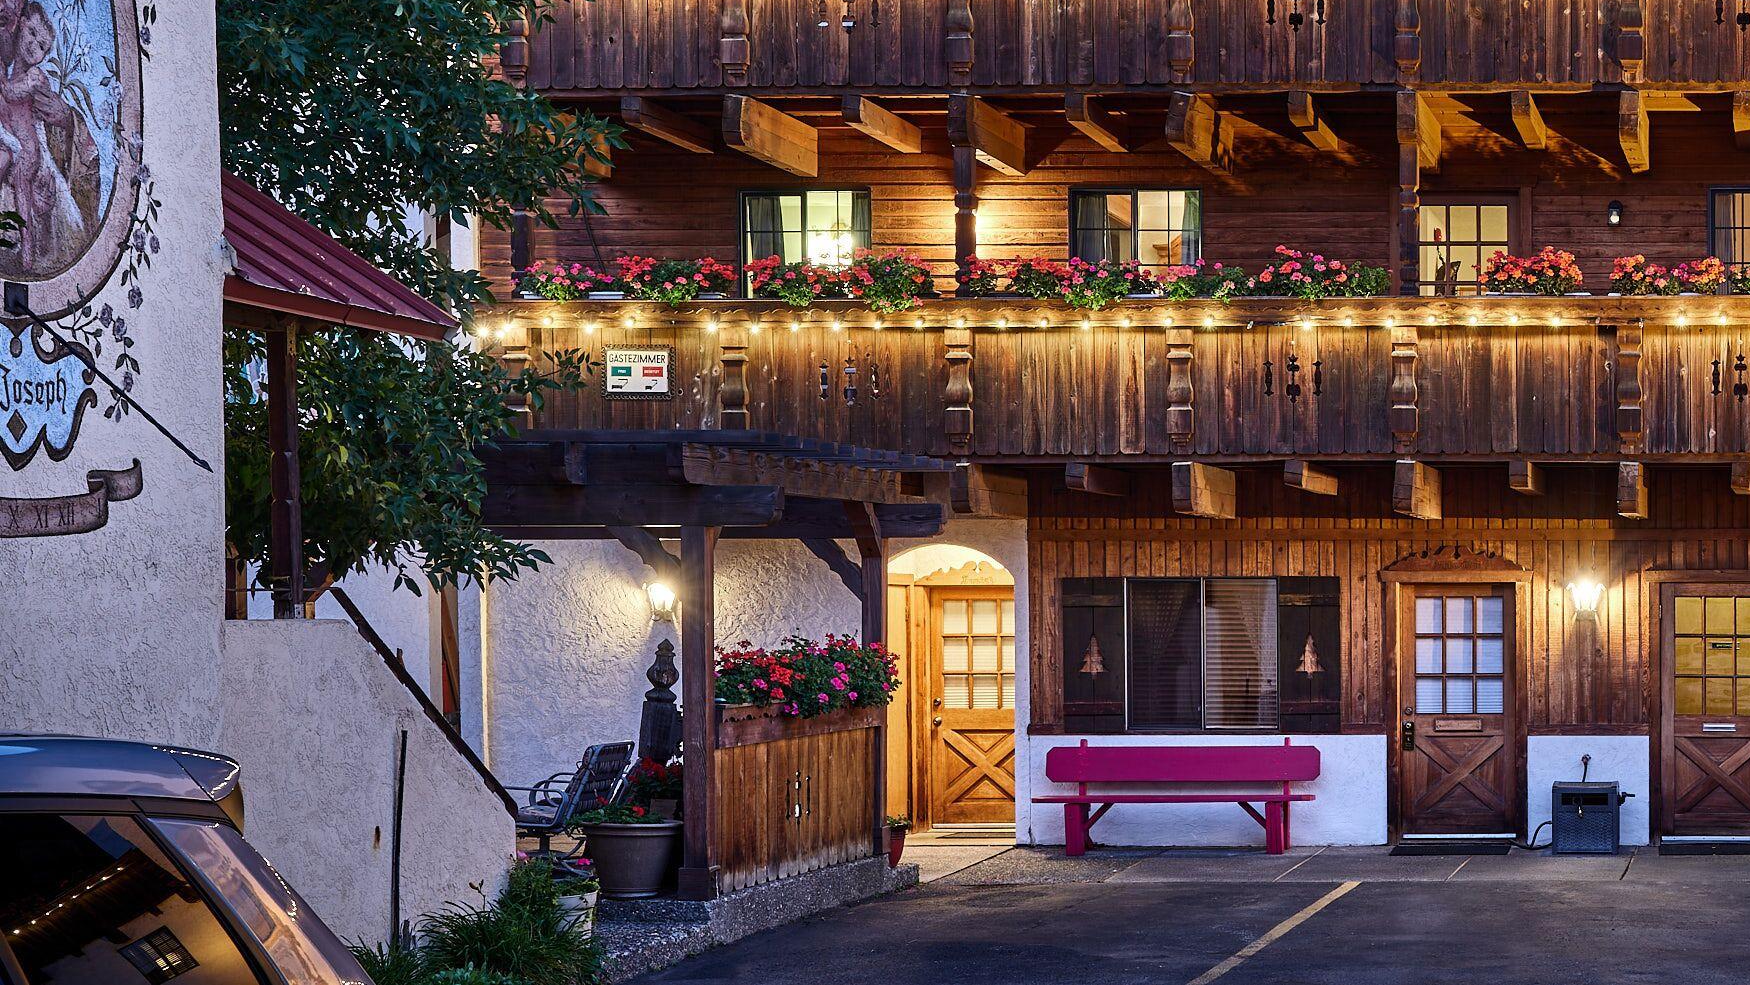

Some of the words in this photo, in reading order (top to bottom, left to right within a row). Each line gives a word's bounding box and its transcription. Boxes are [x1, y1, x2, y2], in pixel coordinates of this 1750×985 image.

[0, 363, 67, 415] Joseph
[32, 504, 49, 528] XI
[58, 502, 75, 526] XII
